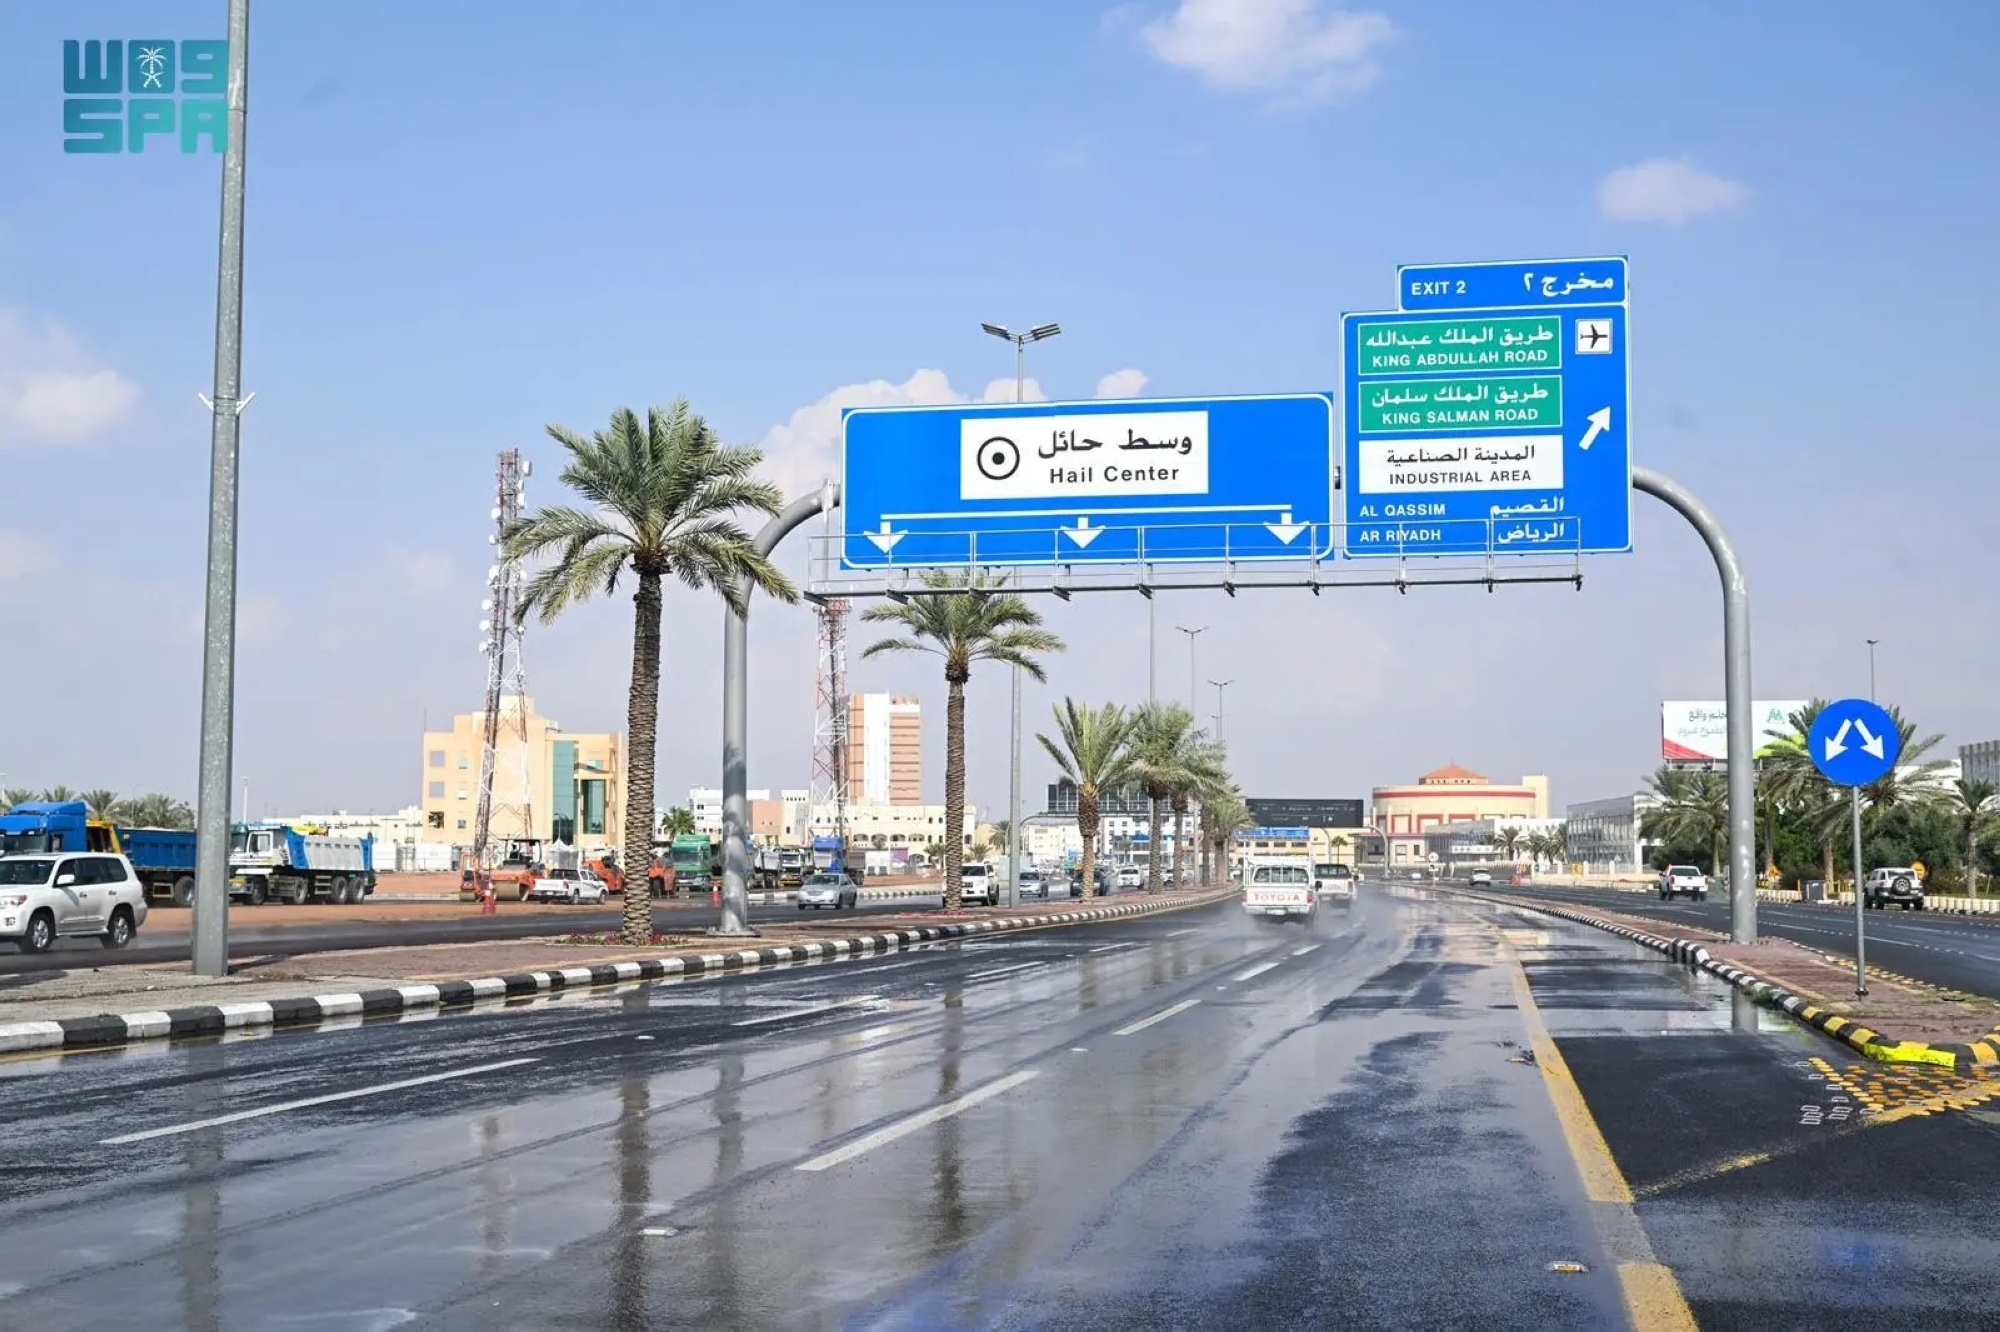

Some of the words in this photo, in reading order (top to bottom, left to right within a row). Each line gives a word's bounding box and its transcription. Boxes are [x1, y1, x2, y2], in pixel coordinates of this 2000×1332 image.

[1411, 282, 1449, 296] EXIT
[1456, 282, 1466, 294] 2
[1523, 272, 1534, 292] ٢
[1541, 272, 1614, 297] مخرج
[1366, 331, 1432, 350] عبدالله
[1438, 328, 1494, 346] الملك
[1499, 324, 1554, 346] طريق
[1372, 354, 1410, 367] KING
[1416, 352, 1499, 366] ABDULLAH
[1504, 350, 1548, 362] ROAD
[1371, 388, 1428, 408] سلمان
[1434, 384, 1488, 403] الملك
[1494, 384, 1548, 406] طريق
[1382, 412, 1420, 425] KING
[1427, 410, 1490, 424] SALMAN
[1495, 408, 1538, 421] ROAD
[1038, 429, 1103, 459] حائل
[1118, 428, 1192, 455] وسط
[1387, 448, 1467, 468] الصناعية
[1474, 444, 1535, 465] المدينة
[1050, 468, 1093, 484] Hail
[1104, 466, 1179, 482] Center
[1390, 471, 1483, 485] INDUSTRIAL
[1490, 470, 1531, 482] AREA
[1359, 505, 1378, 516] AL
[1384, 504, 1446, 516] QASSIM
[1490, 495, 1564, 519] القصيم
[1360, 530, 1380, 542] AR
[1386, 529, 1441, 542] RIYADH
[1498, 521, 1564, 544] الرياض
